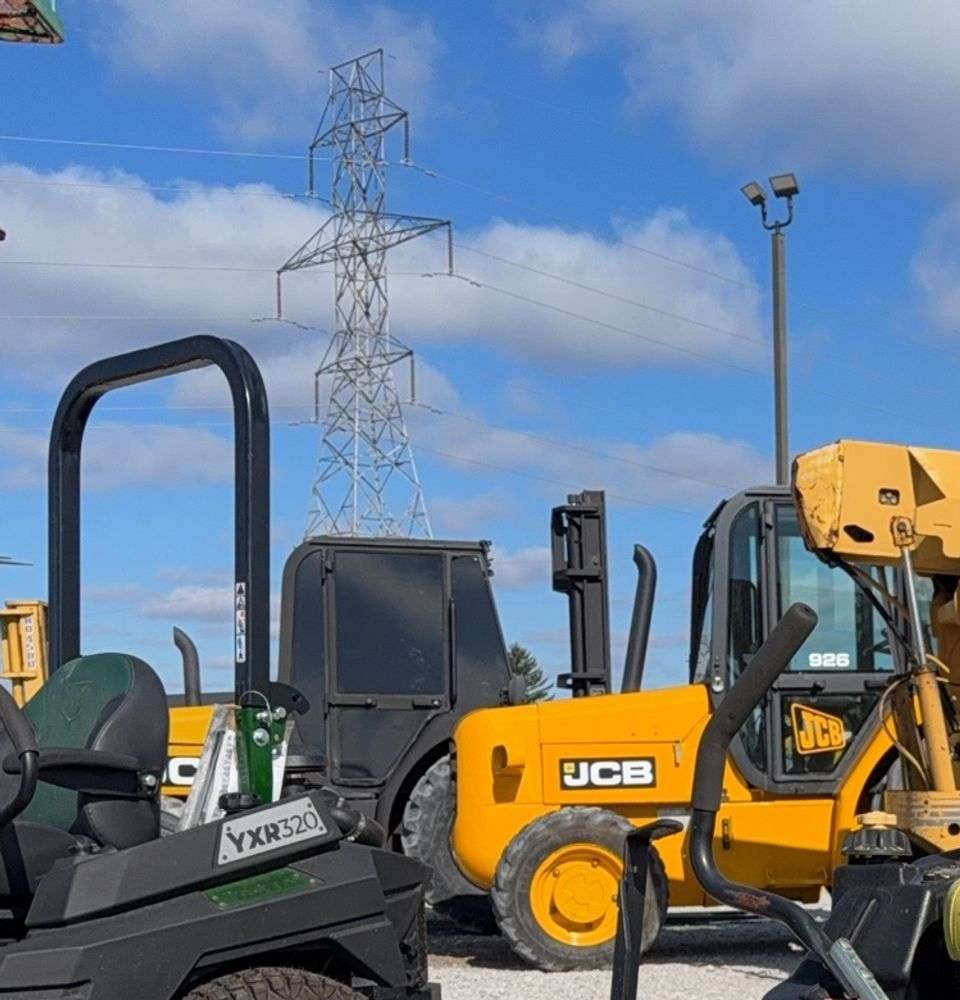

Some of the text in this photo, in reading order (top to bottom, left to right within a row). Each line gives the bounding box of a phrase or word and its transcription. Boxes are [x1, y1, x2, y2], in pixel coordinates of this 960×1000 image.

[808, 652, 850, 668] 926
[799, 709, 842, 750] JCB
[563, 760, 654, 787] JCB
[225, 811, 319, 853] YXR320
